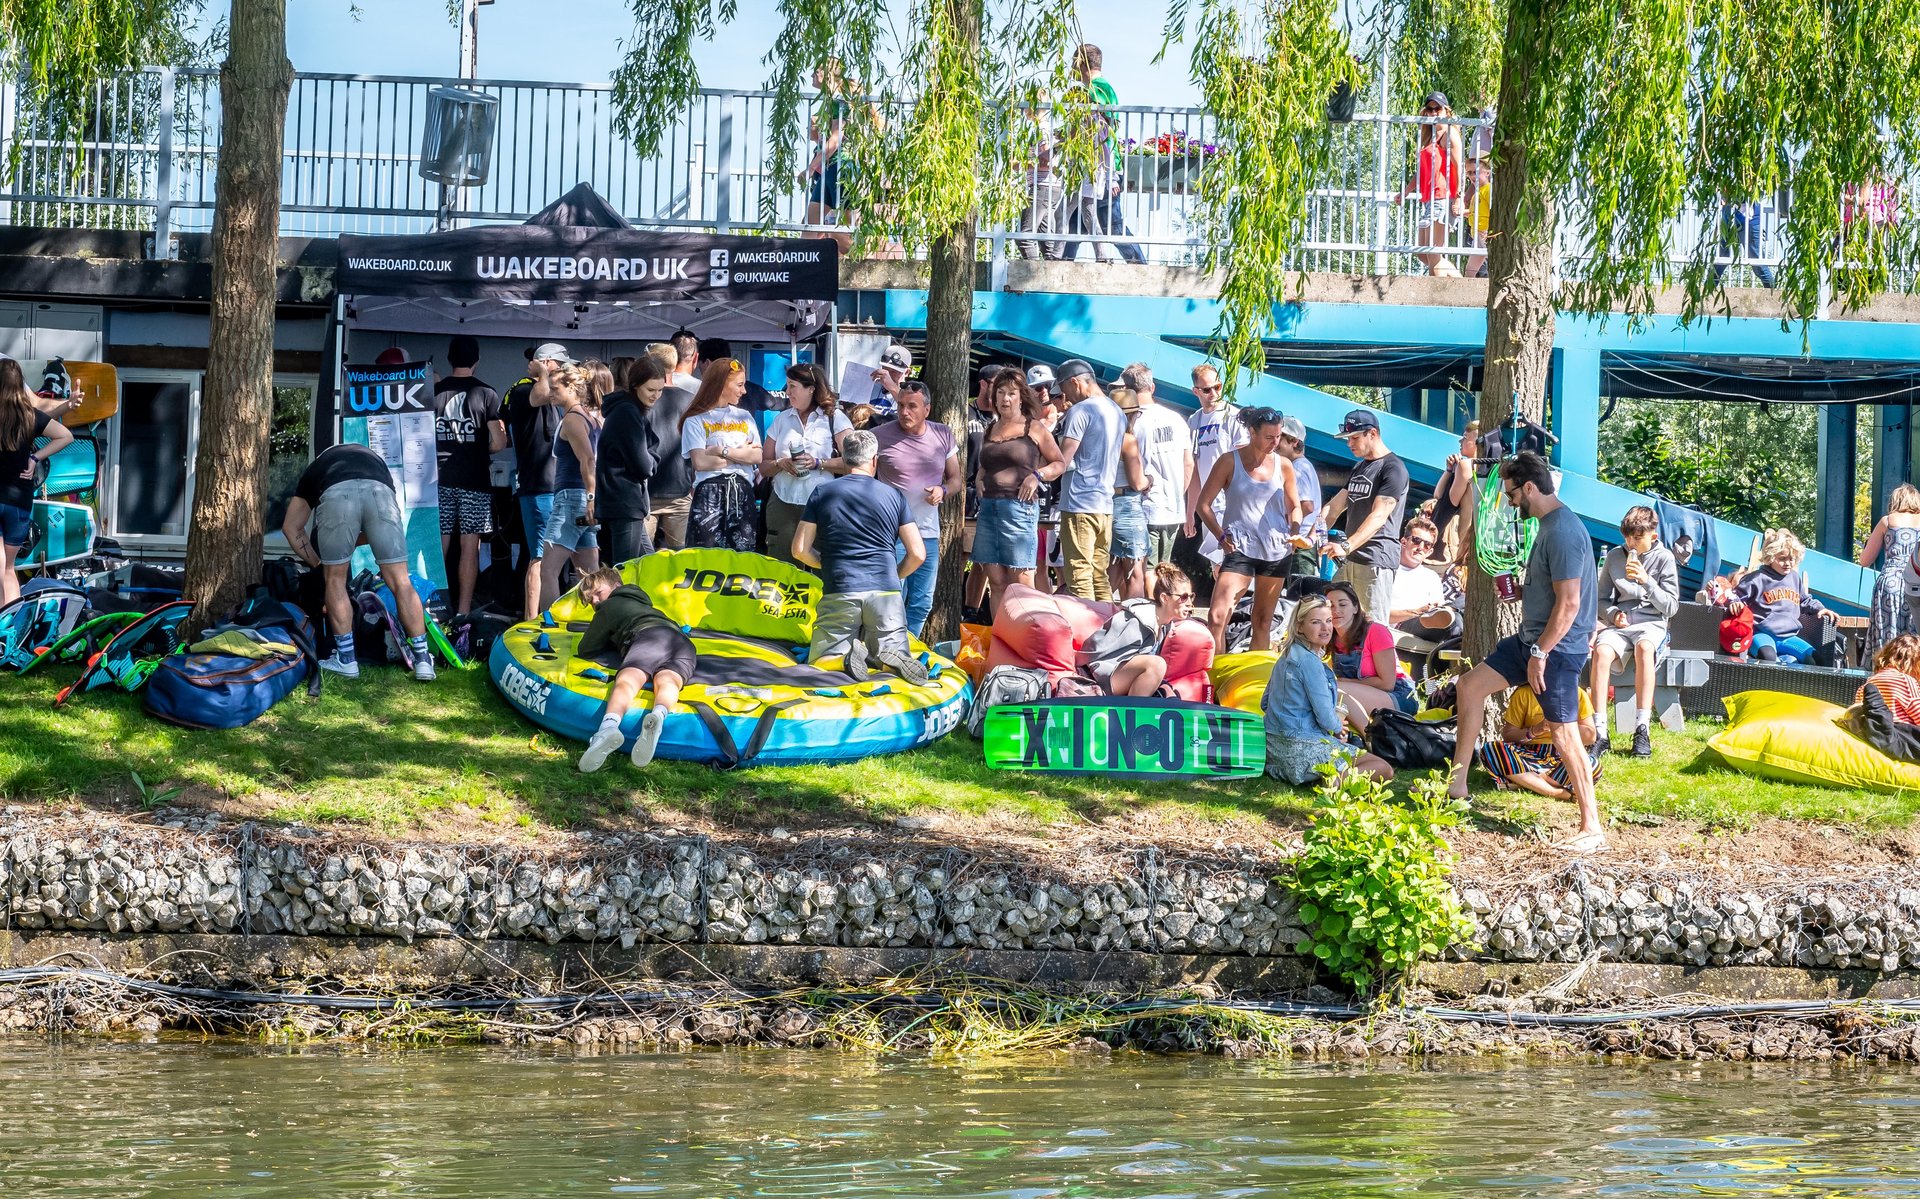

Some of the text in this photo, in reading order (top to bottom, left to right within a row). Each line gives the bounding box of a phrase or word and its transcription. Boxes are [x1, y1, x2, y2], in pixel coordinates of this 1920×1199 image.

[348, 257, 452, 272] WAKEBOARD.CO.UK
[734, 251, 820, 263] /WAKEBOARDUK
[476, 256, 690, 281] WAKEBOARD UK
[733, 271, 790, 283] @UKWAKE
[347, 368, 426, 382] Wakeboard UK
[349, 383, 426, 412] WUK
[1021, 708, 1232, 774] RONIX
